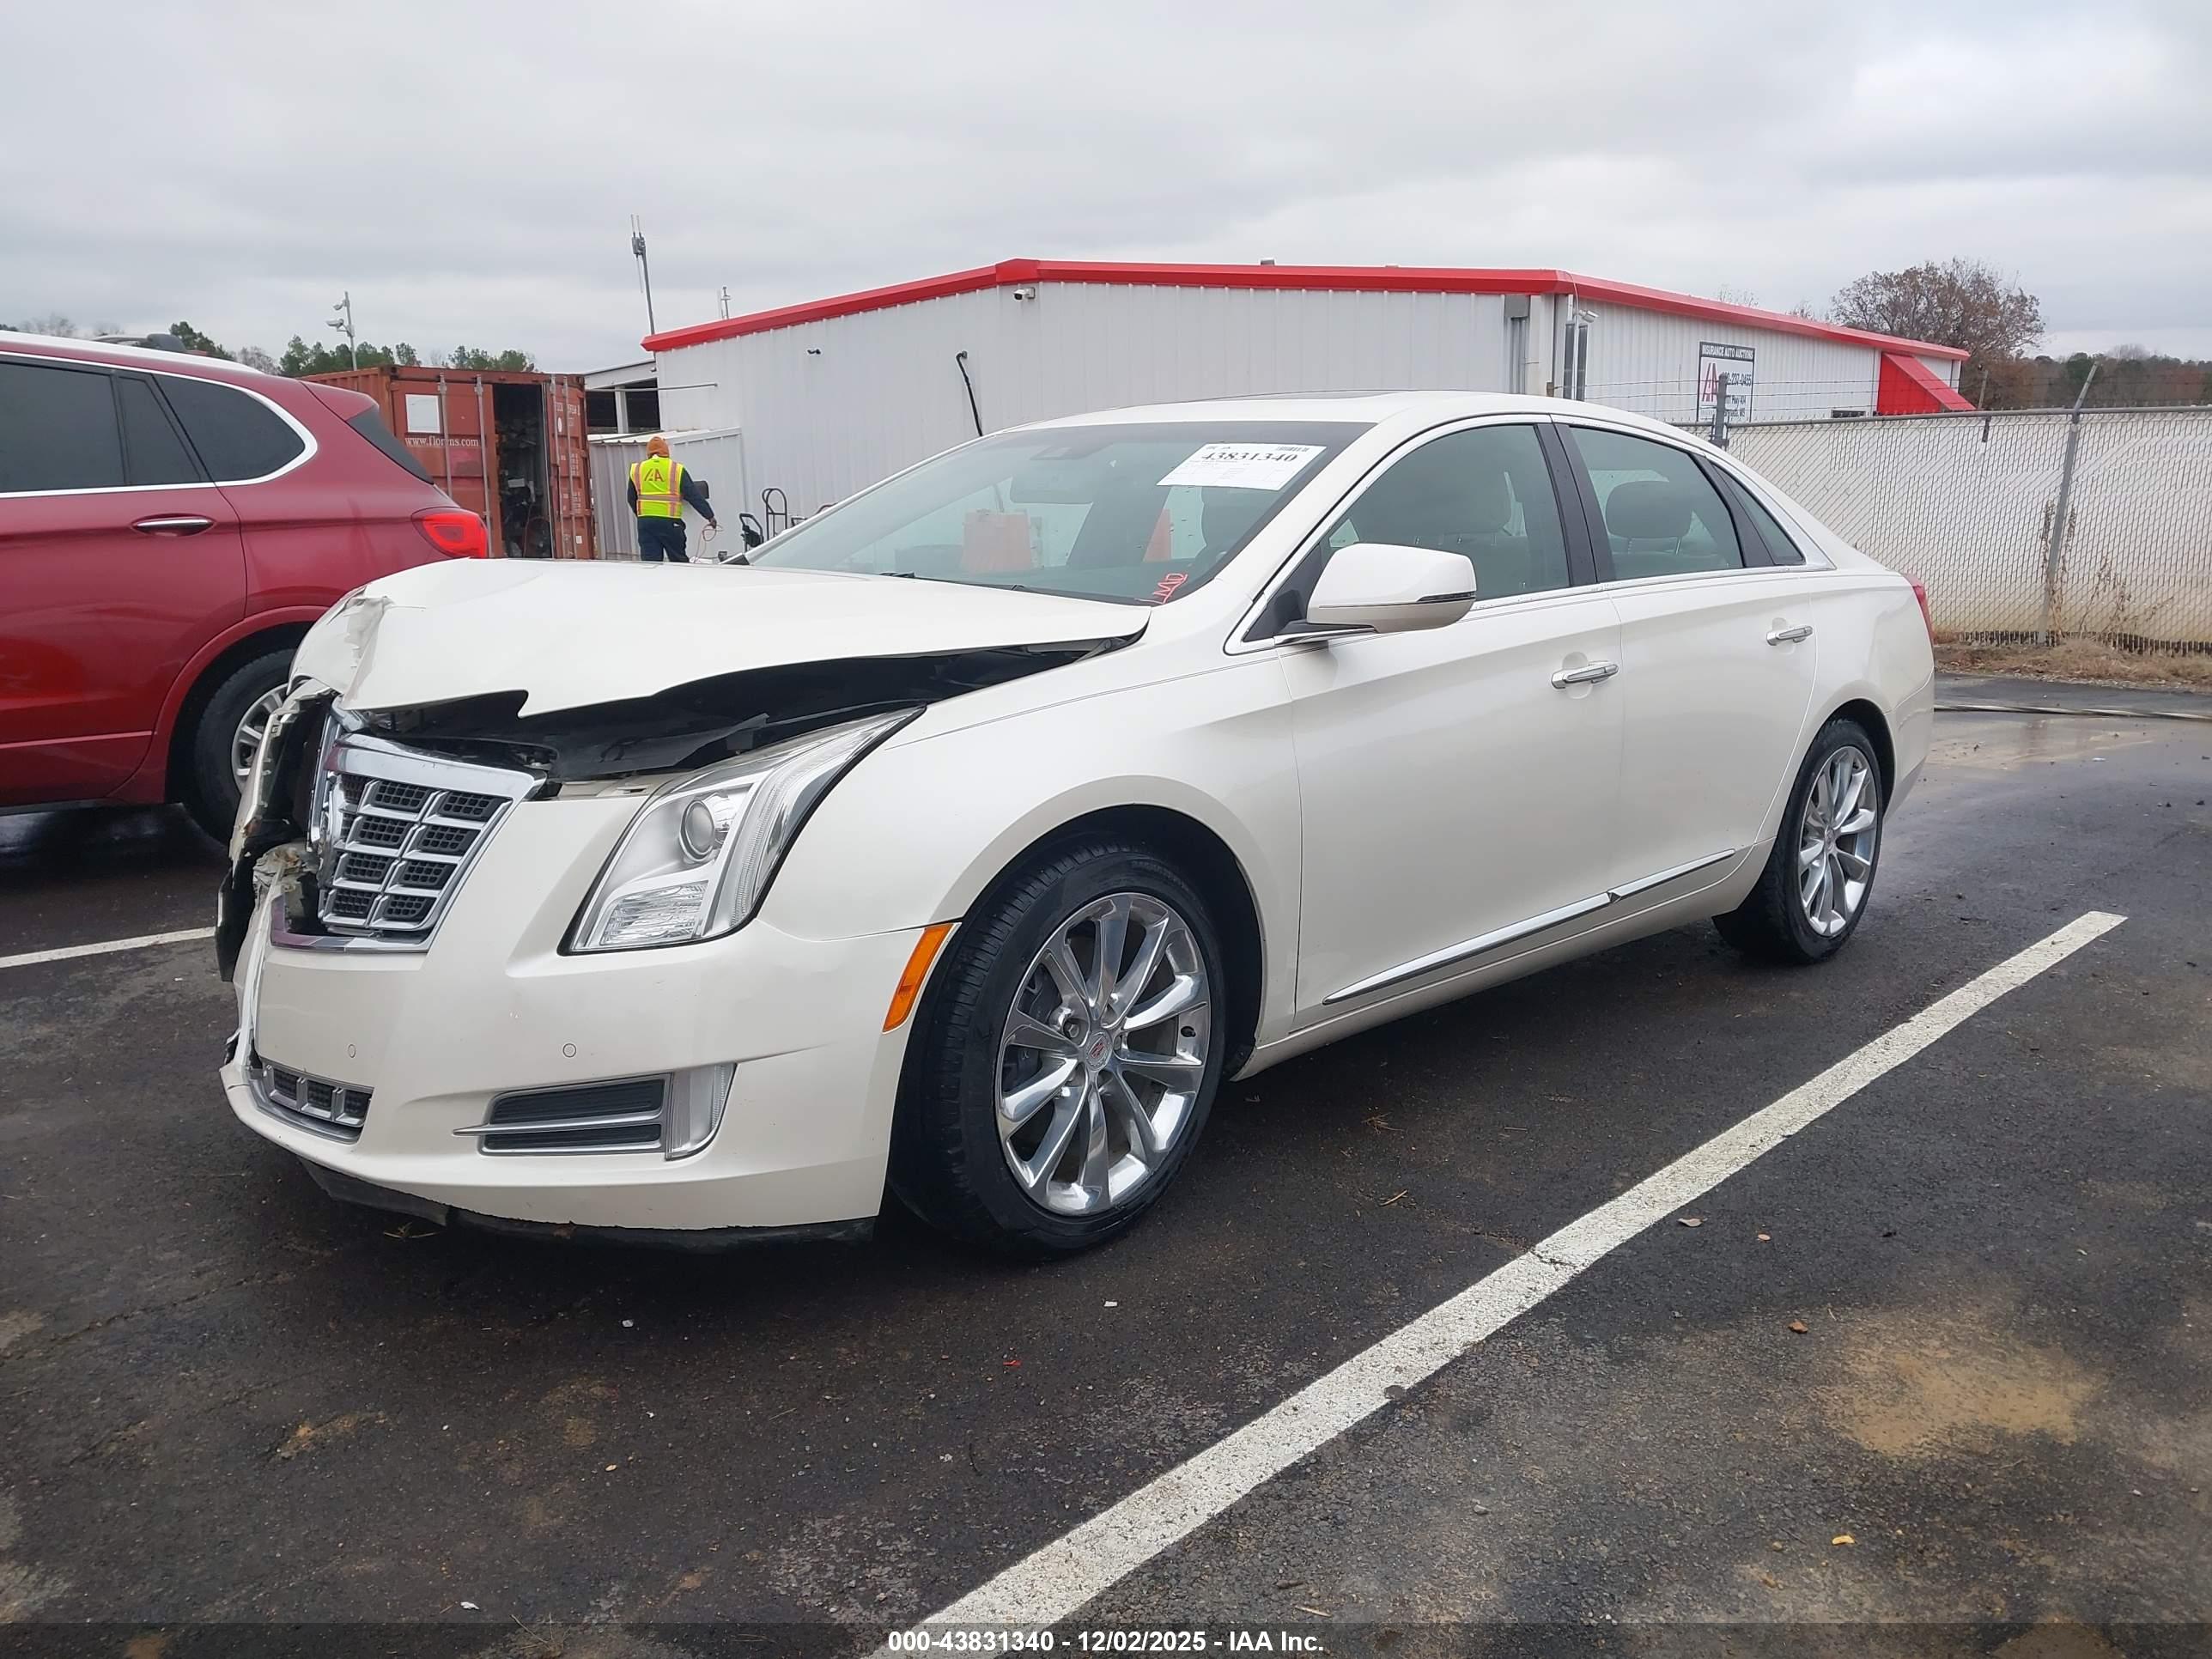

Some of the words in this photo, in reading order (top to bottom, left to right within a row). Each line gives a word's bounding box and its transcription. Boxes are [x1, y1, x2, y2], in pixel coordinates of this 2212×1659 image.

[1702, 344, 1724, 356] INSURANCE
[1724, 347, 1735, 358] AUTO
[1735, 348, 1753, 360] AUCTIONS
[405, 435, 478, 447] www.florns.com
[1202, 452, 1298, 462] 43831340
